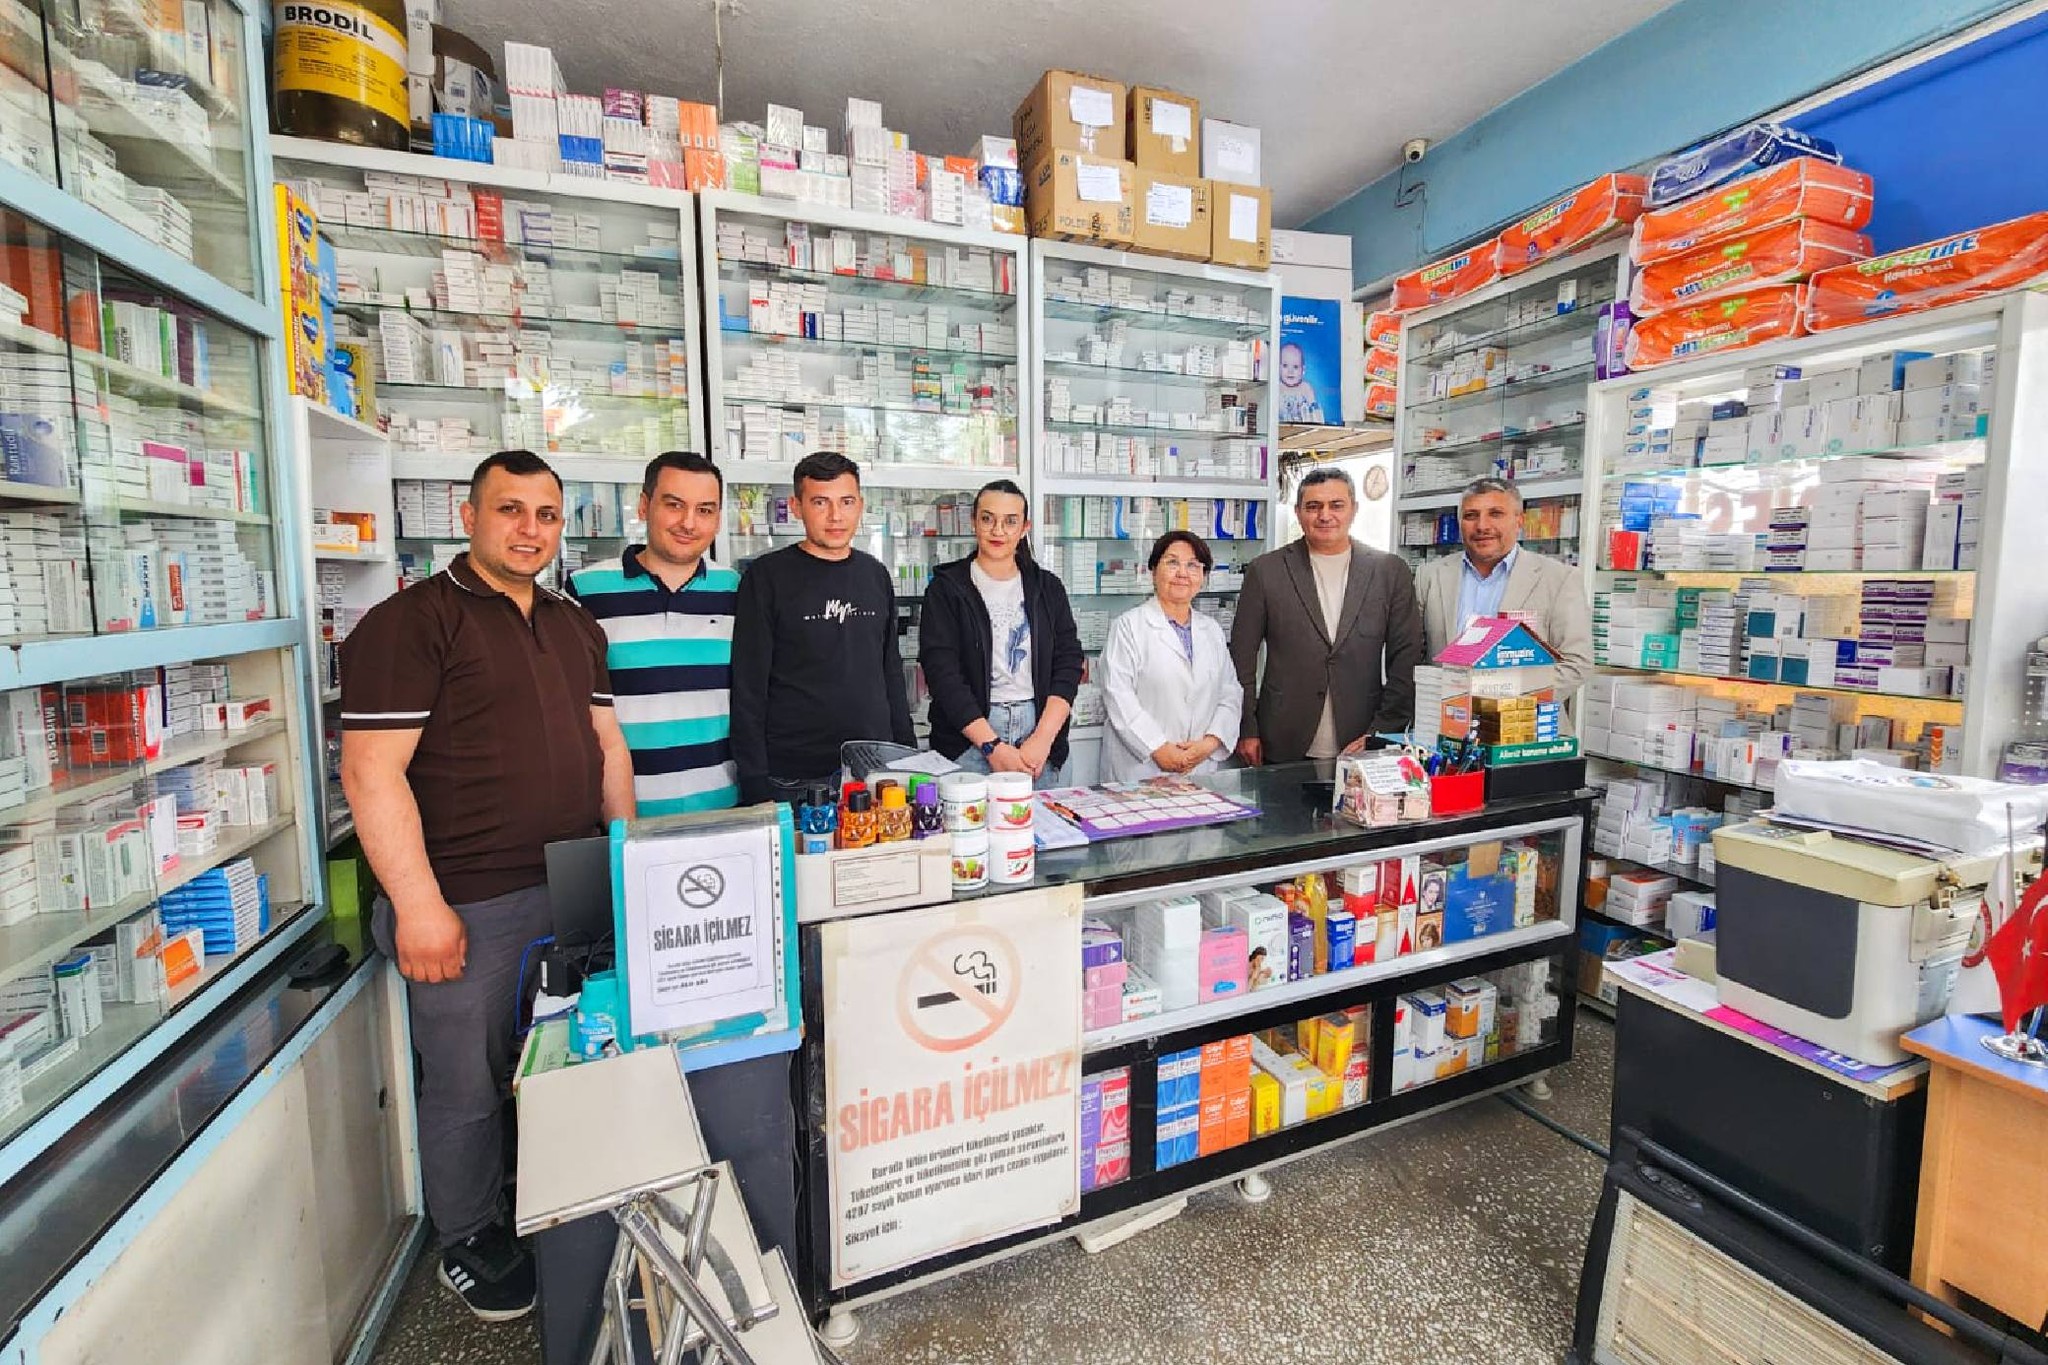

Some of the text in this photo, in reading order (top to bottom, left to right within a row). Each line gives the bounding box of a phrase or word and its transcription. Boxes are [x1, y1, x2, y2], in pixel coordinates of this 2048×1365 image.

[285, 6, 374, 41] BRODİL
[1858, 233, 1980, 276] FRESHLIFE
[653, 915, 752, 951] SİGARA İÇİLMEZ
[839, 1052, 1073, 1153] SİGARA İÇİLMEZ
